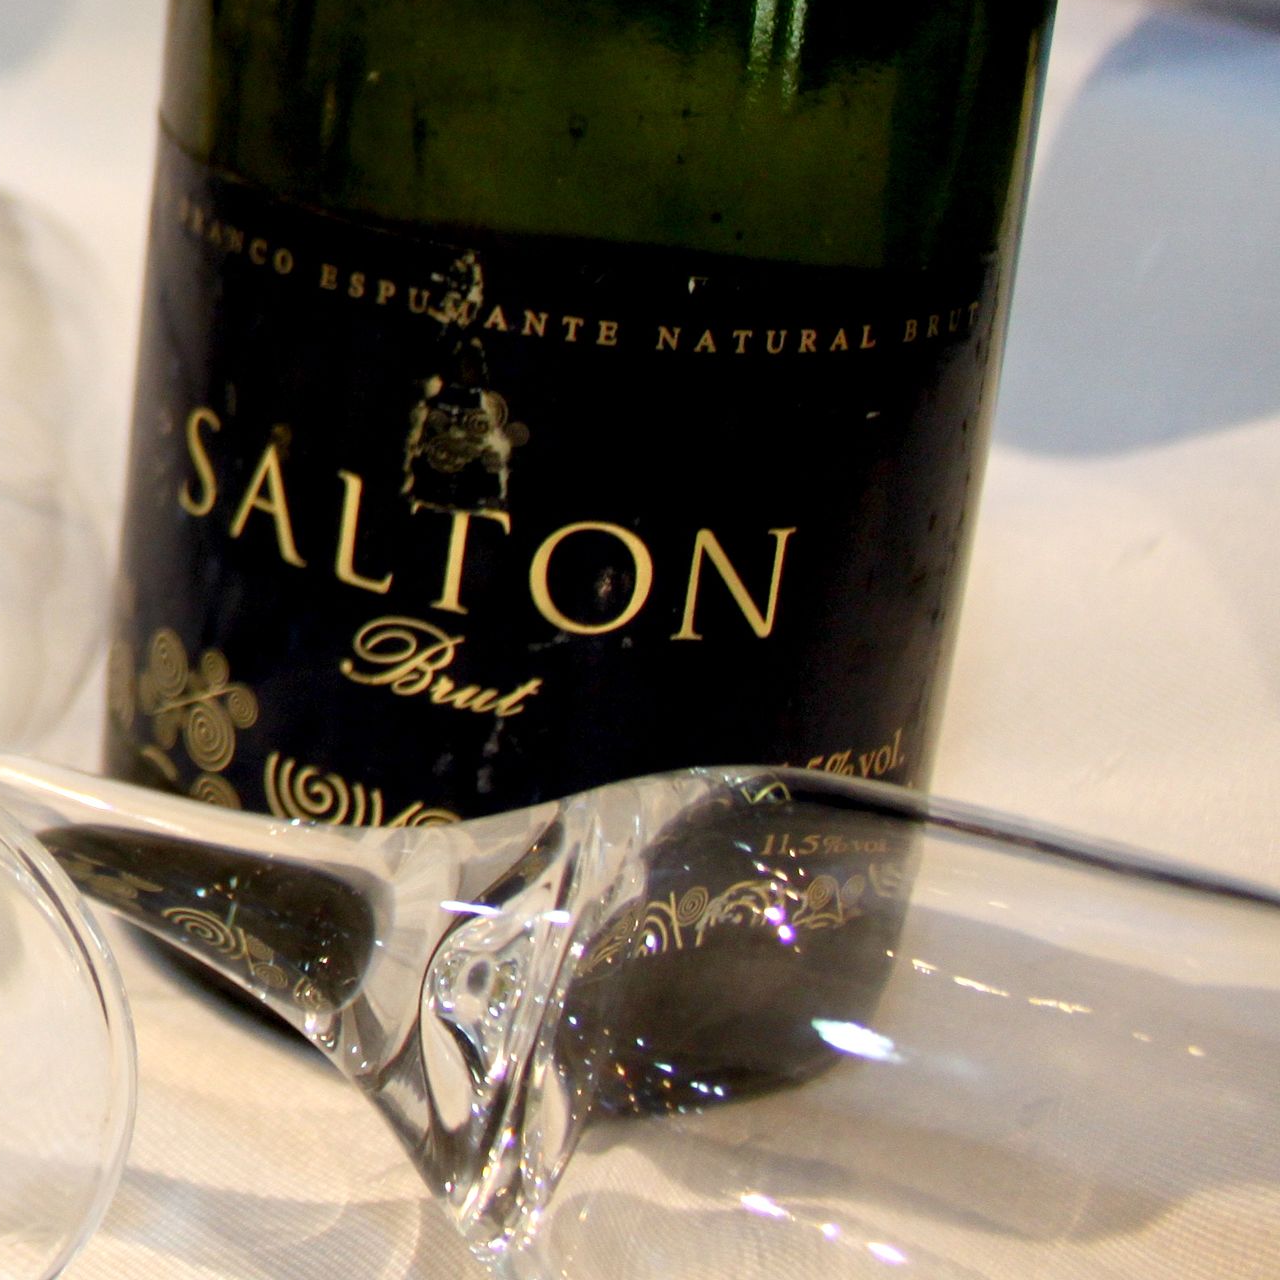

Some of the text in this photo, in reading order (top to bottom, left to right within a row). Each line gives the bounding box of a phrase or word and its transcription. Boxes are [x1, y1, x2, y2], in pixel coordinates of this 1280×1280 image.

[655, 323, 877, 354] NATURAL
[902, 300, 983, 343] BRUT
[176, 405, 797, 641] SALTON
[340, 615, 543, 719] Brut
